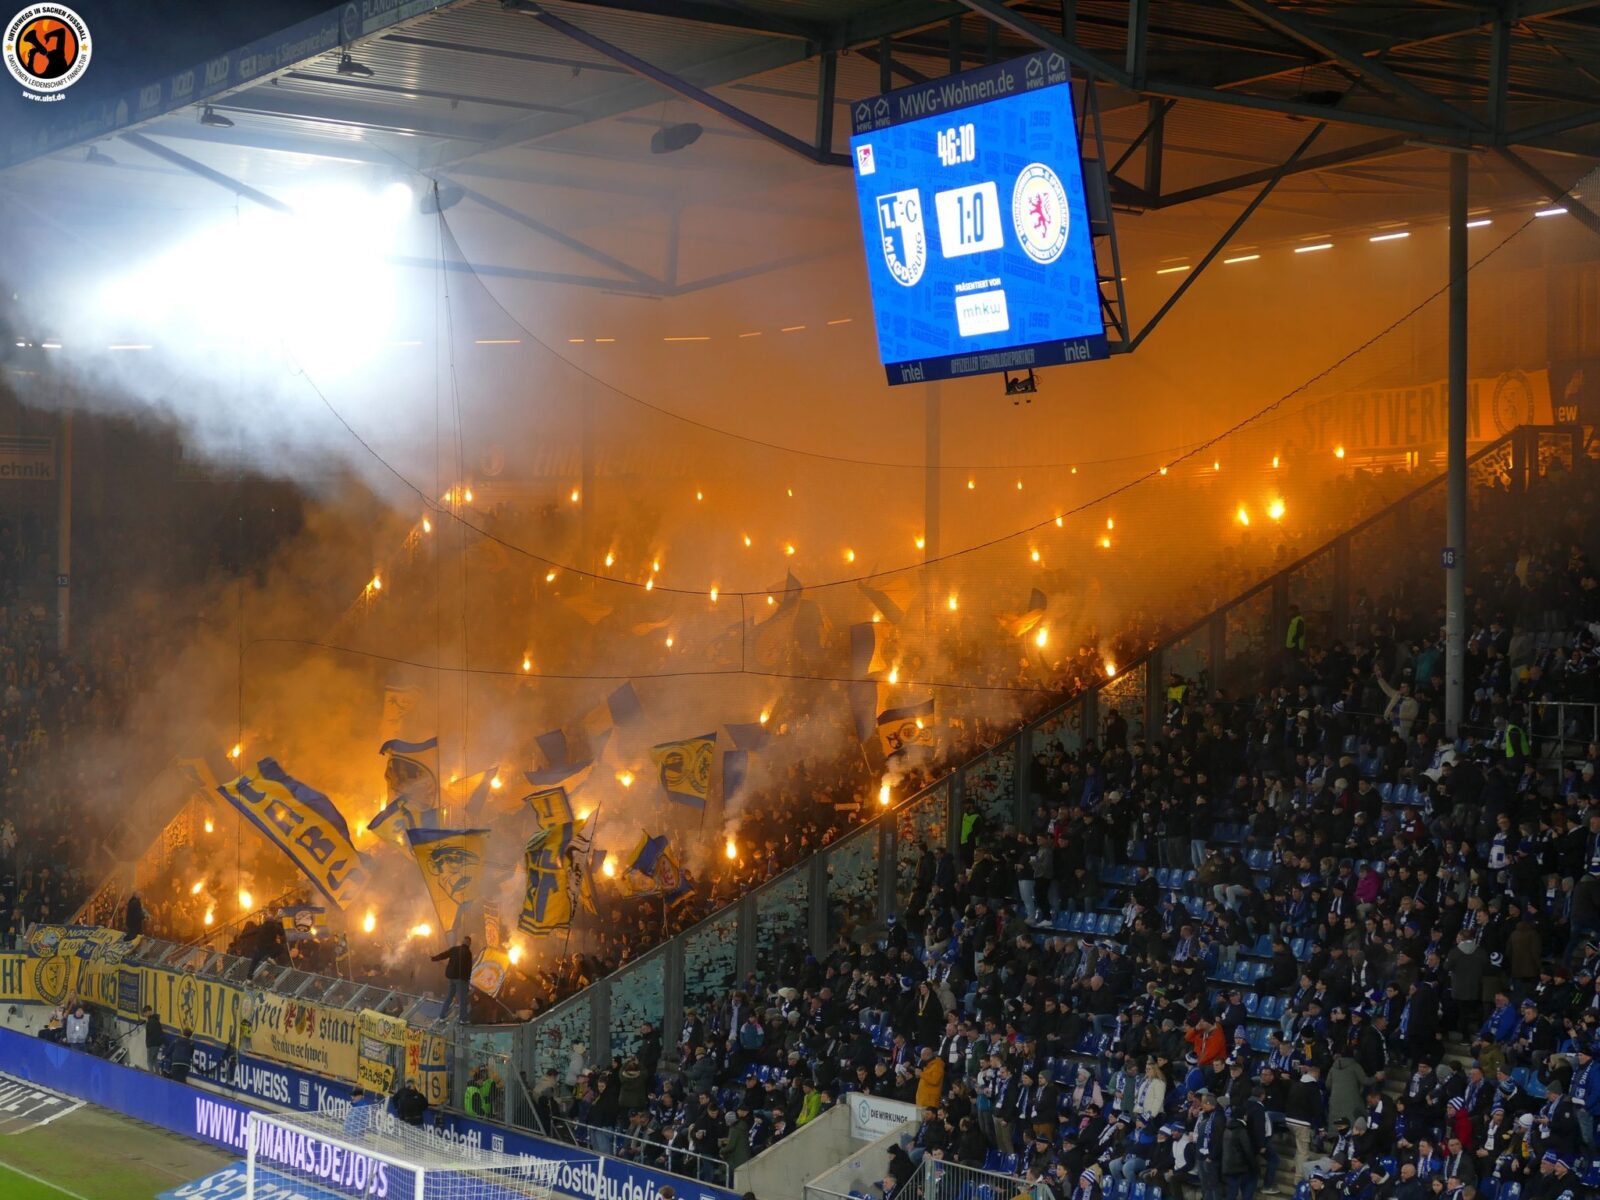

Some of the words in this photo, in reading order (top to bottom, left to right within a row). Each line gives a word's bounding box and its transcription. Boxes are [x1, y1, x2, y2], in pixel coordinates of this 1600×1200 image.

[900, 69, 1015, 119] MWG-Wohnen.de
[937, 123, 975, 167] 46:10
[957, 191, 984, 245] 1:0
[1064, 339, 1091, 361] intel
[901, 362, 924, 382] intel
[1302, 383, 1481, 452] SPORTVEREN
[1442, 551, 1454, 565] 16
[320, 1013, 356, 1045] staat
[271, 1034, 329, 1069] Braunschweig
[195, 1097, 389, 1198] WWW.HUMANAS.DE/JOBS
